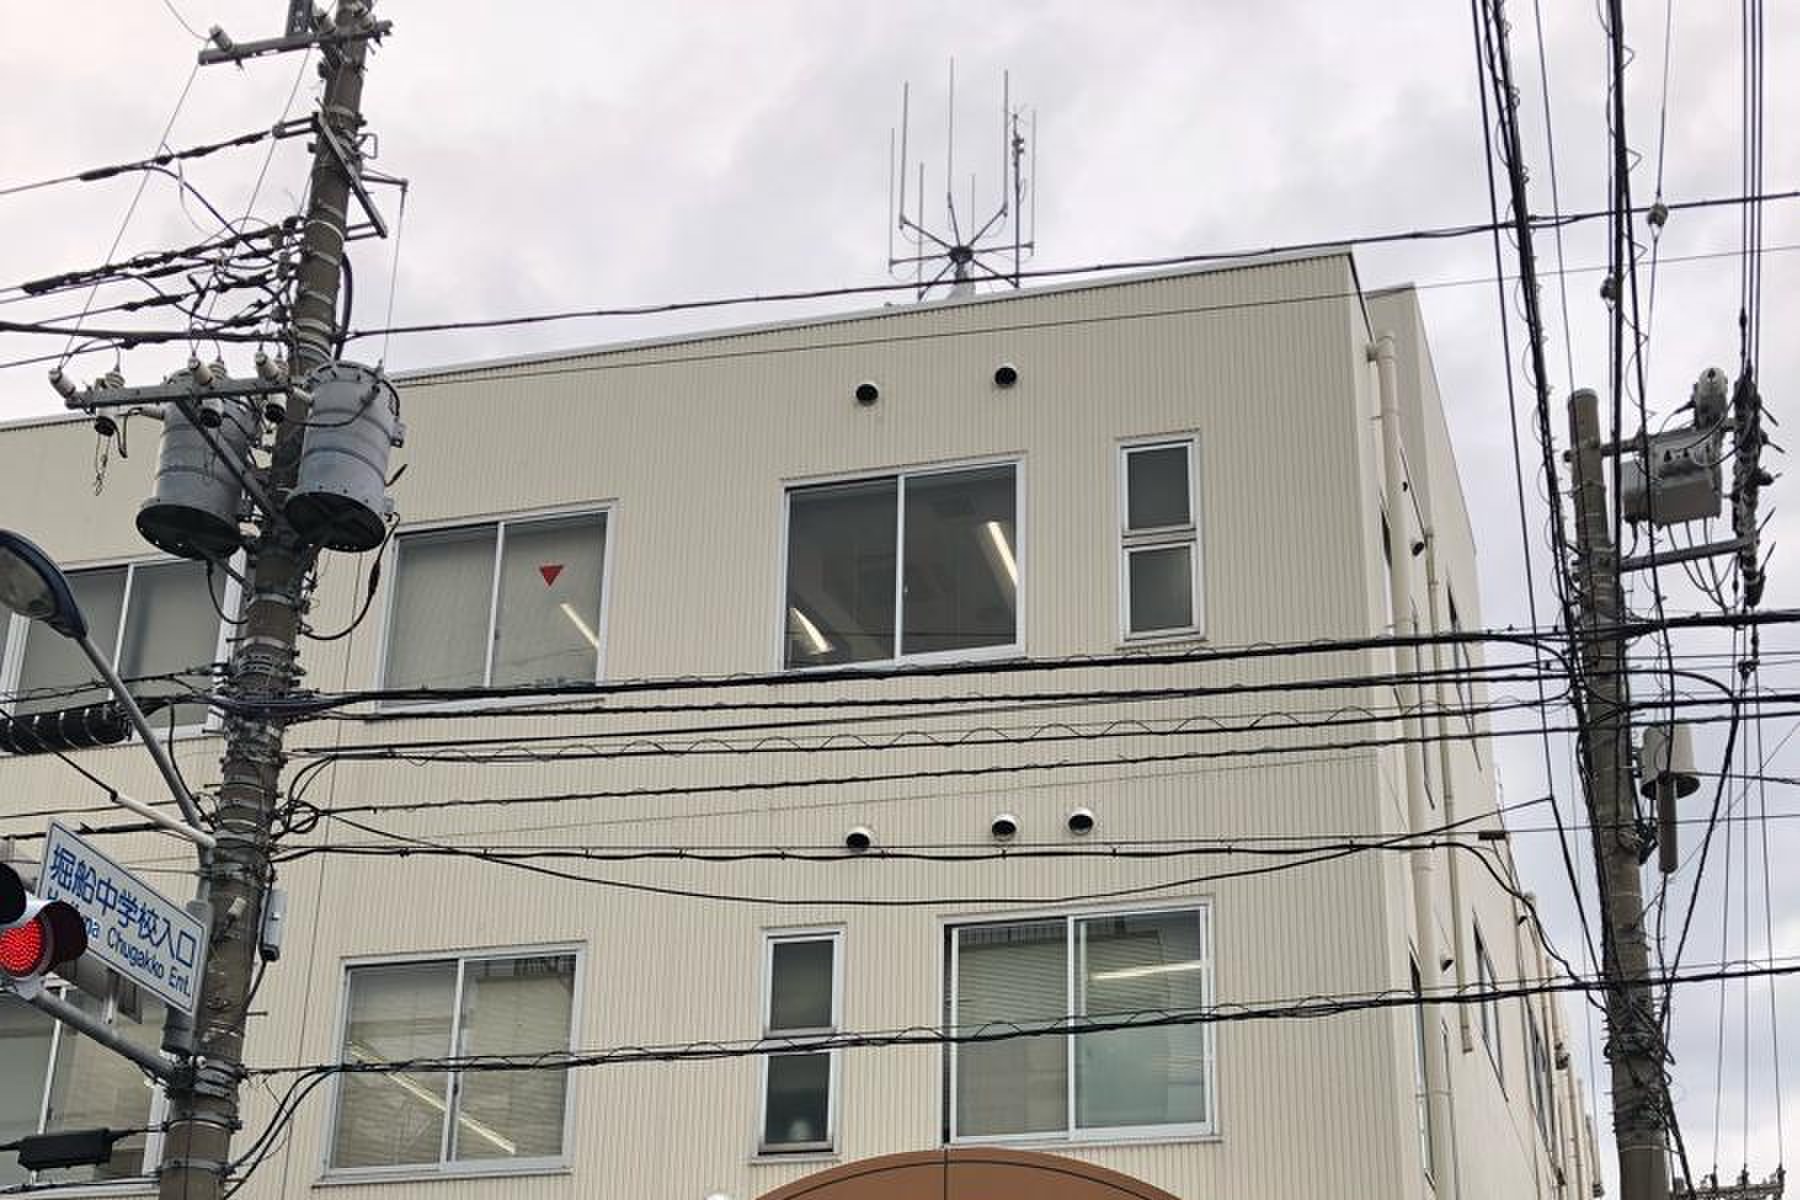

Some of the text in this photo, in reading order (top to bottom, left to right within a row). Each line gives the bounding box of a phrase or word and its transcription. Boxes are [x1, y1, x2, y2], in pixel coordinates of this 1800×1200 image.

[50, 844, 197, 968] 堀船中学校入口
[107, 927, 191, 997] Chugakko Ent.
